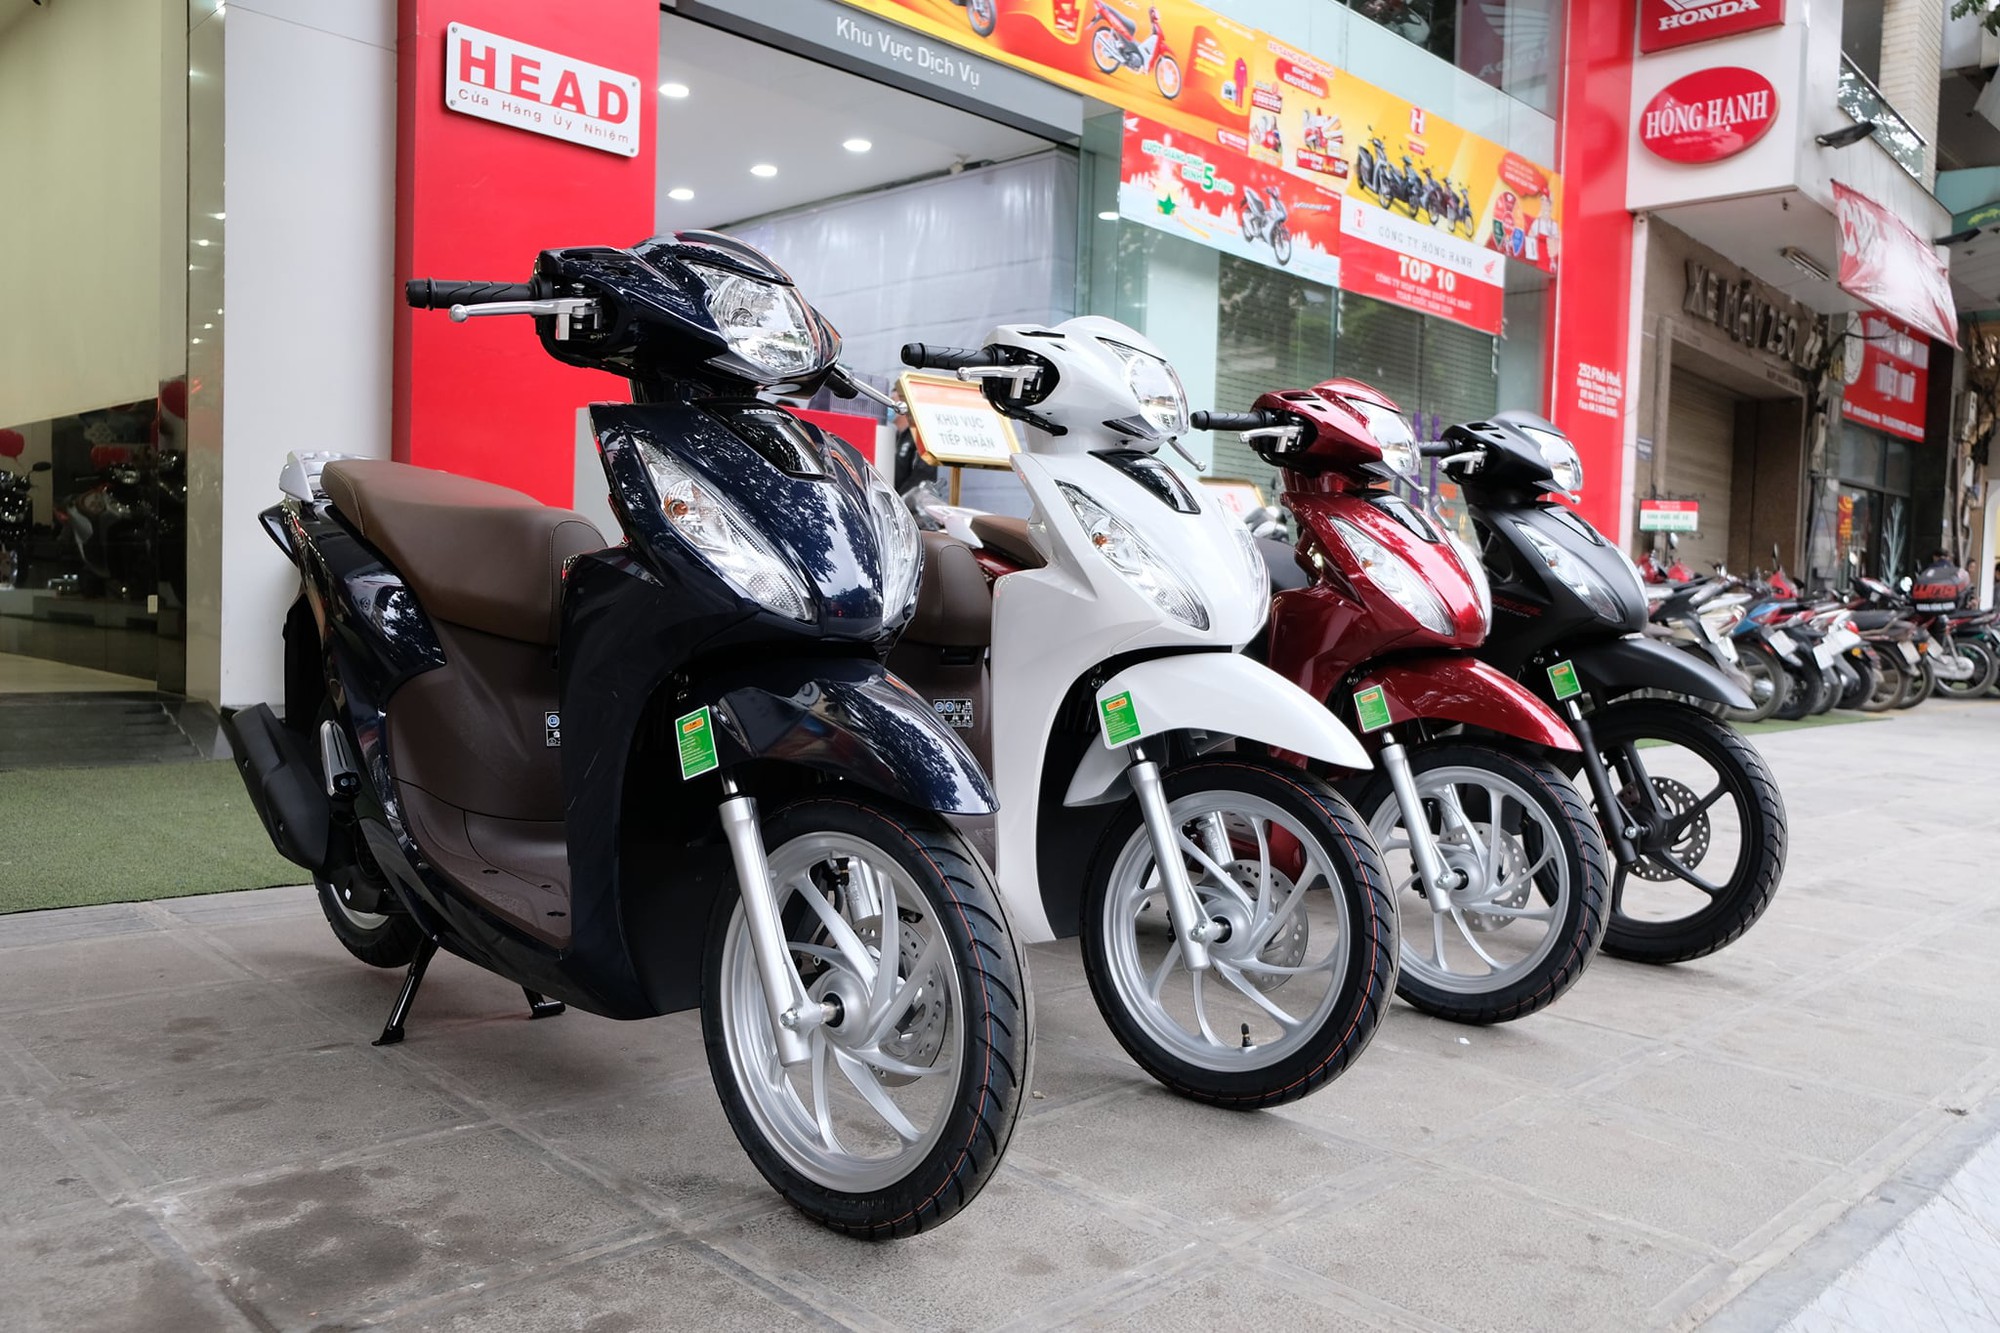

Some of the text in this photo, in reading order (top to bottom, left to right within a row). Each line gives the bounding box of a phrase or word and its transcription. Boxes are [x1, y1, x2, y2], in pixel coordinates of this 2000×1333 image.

[1658, 0, 1761, 31] HONDA
[836, 16, 980, 90] Khu Vực Dịch Vụ
[459, 38, 629, 125] HEAD
[502, 100, 542, 123] Hàng
[1645, 90, 1769, 139] HỒNG HẠNH
[1203, 165, 1214, 190] 5
[1398, 254, 1456, 293] TOP 10
[935, 413, 957, 427] KHU
[938, 429, 960, 446] TIẾP
